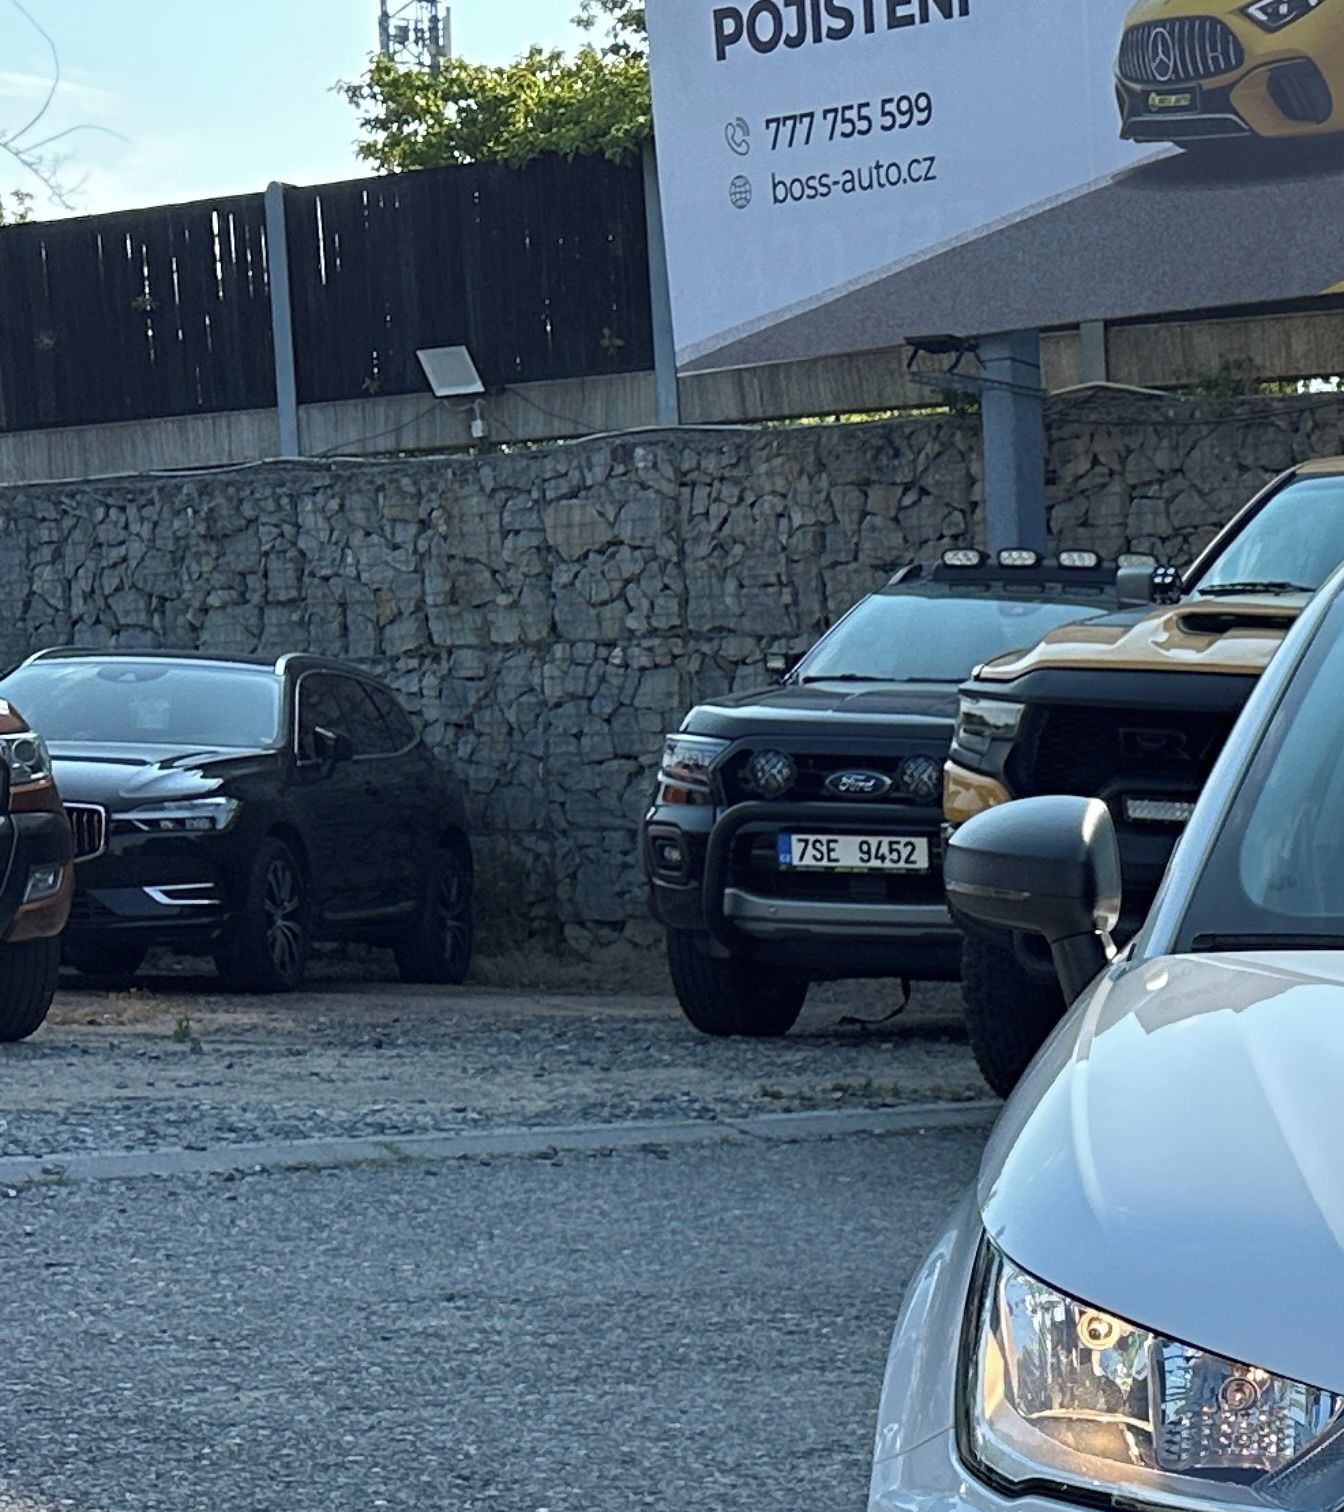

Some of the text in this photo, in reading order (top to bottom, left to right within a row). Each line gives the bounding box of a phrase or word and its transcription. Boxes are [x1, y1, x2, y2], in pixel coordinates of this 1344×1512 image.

[765, 91, 932, 150] 777 755 599
[771, 155, 937, 205] boss-auto.cz
[796, 838, 917, 865] 7SE 9452
